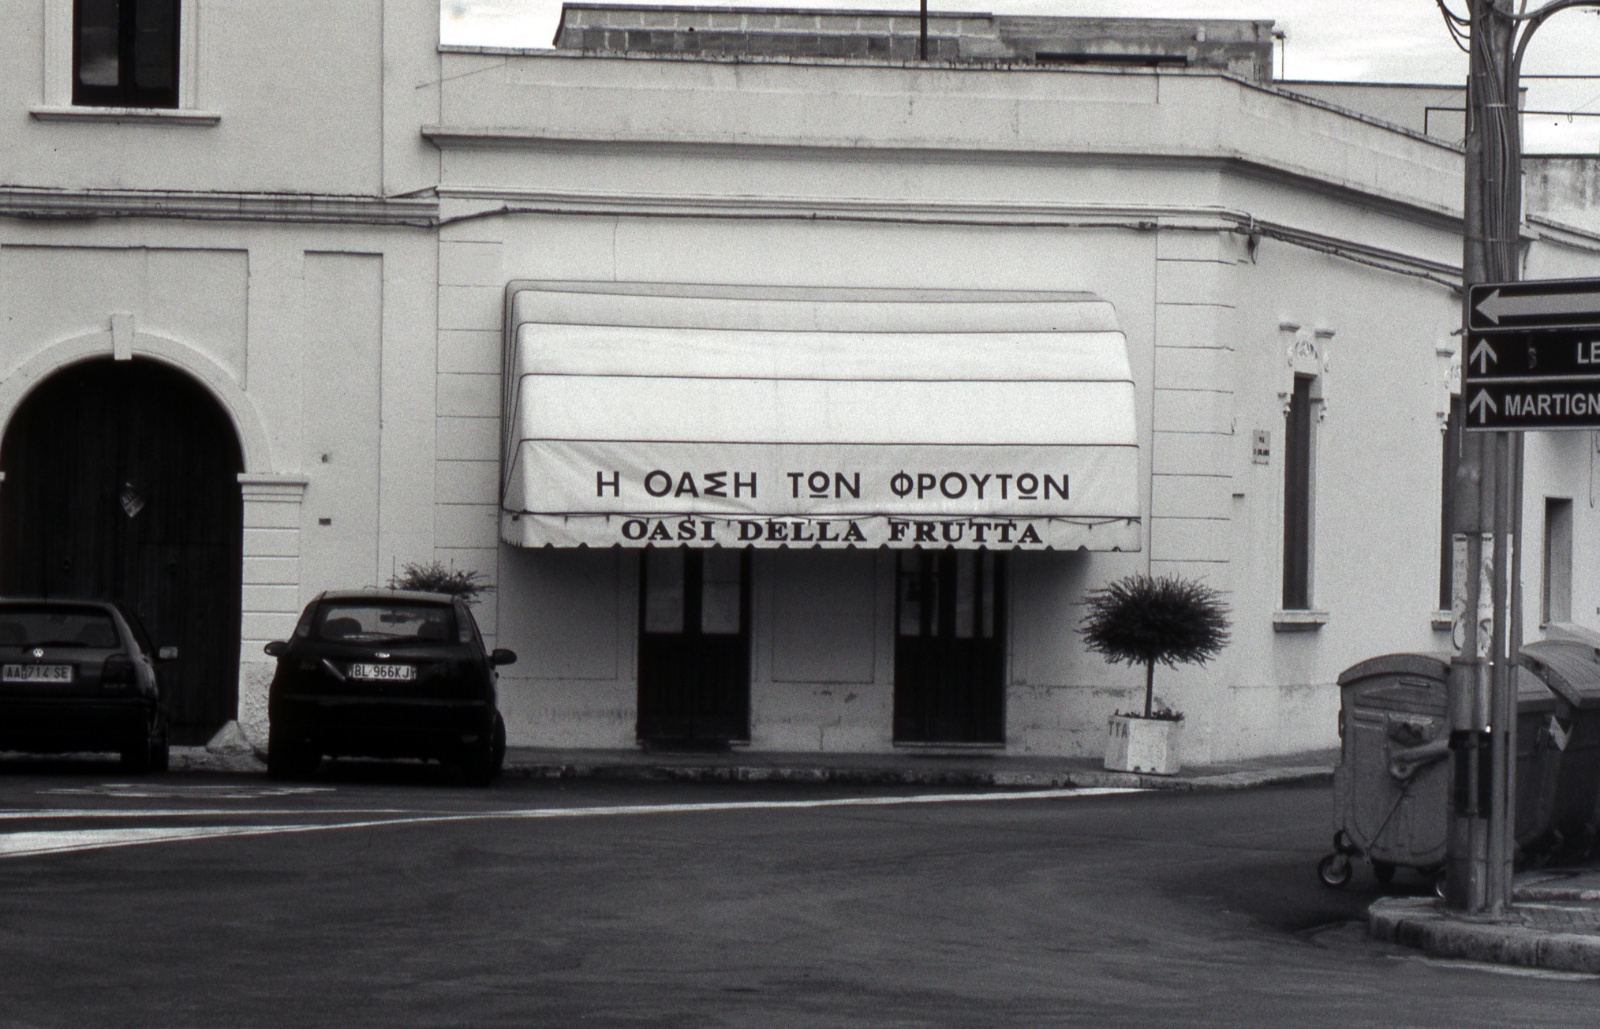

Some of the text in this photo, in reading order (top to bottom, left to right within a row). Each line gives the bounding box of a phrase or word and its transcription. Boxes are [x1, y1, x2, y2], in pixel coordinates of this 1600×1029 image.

[1578, 342, 1600, 364] LE
[1505, 393, 1600, 416] MARTIGN
[597, 470, 1069, 499] Η ΟΑΣΗ ΤΩΝ ΦΡΟΥΤΩΝ
[622, 520, 1042, 543] OASI DELLA FRUTTA
